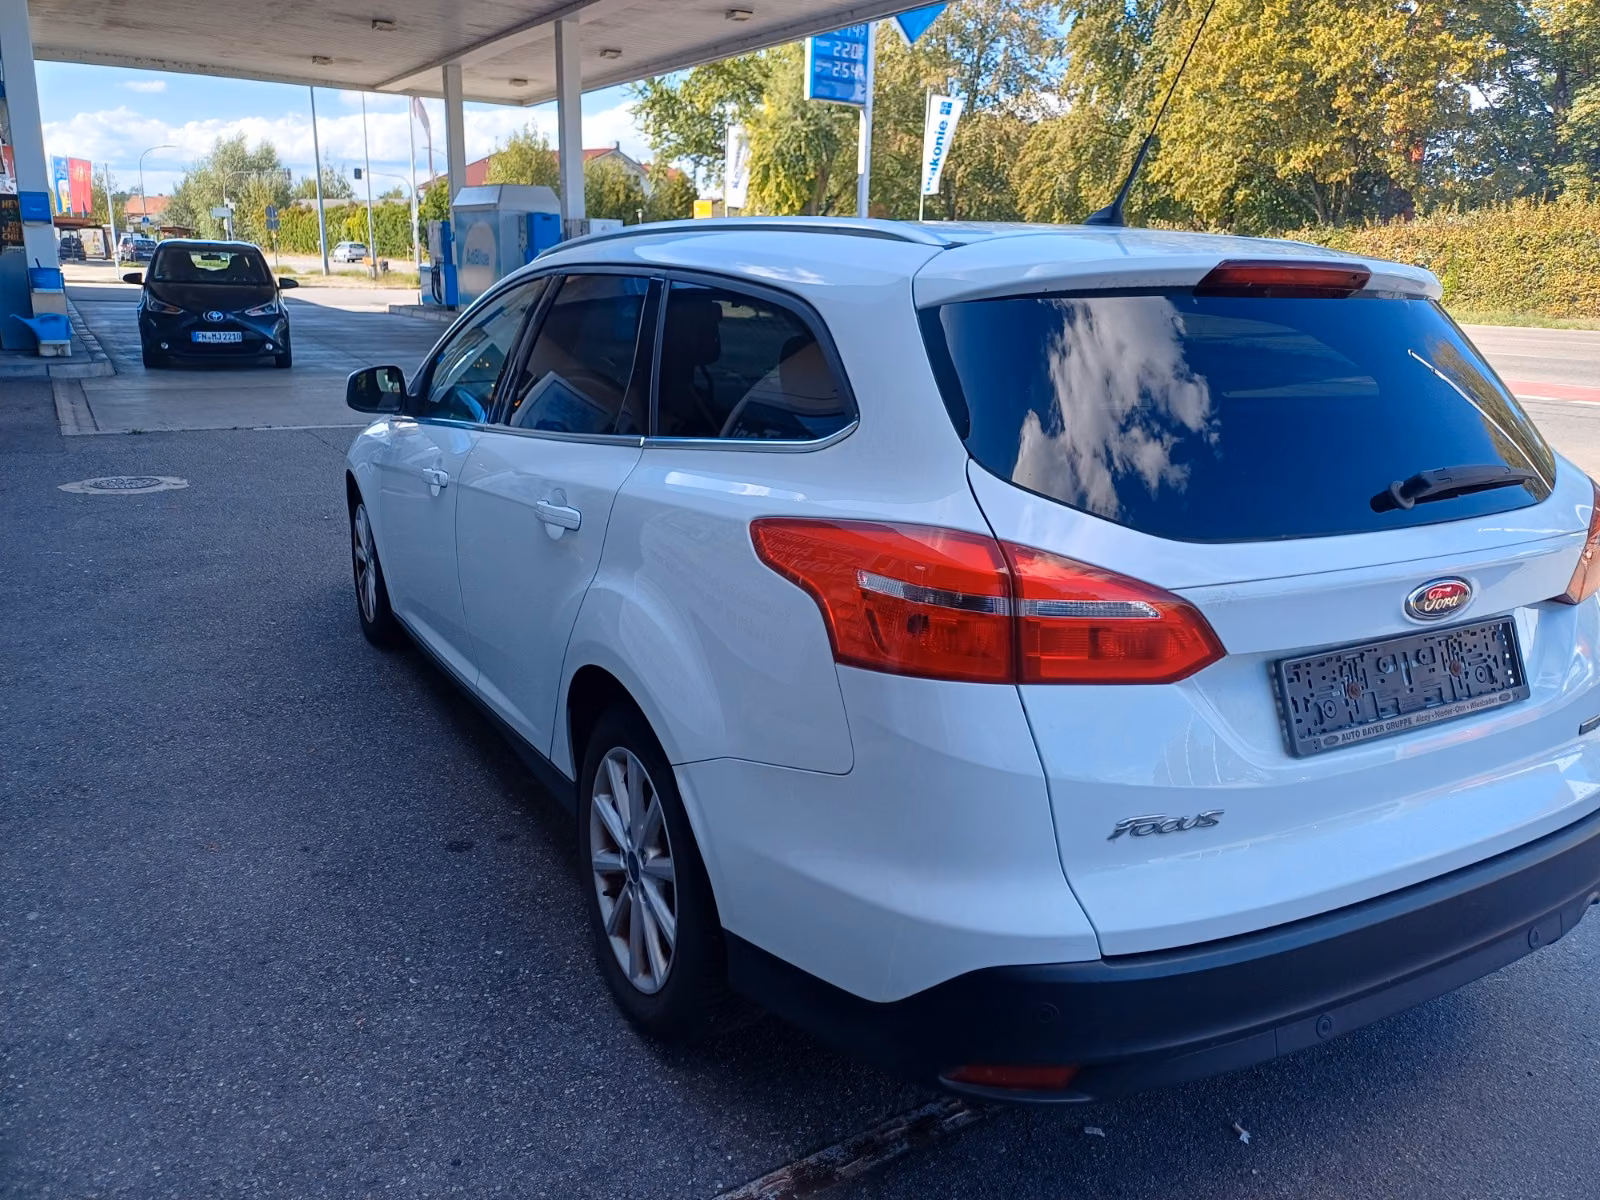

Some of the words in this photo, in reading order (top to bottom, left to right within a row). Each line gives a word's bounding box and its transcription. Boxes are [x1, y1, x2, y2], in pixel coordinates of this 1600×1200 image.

[1424, 586, 1461, 612] Ford
[1341, 730, 1361, 742] AUTO
[1362, 724, 1385, 737] BAYER
[1385, 717, 1412, 731] GRUPPE
[1469, 696, 1498, 709] Wiesbaden
[1106, 809, 1225, 841] Focus
